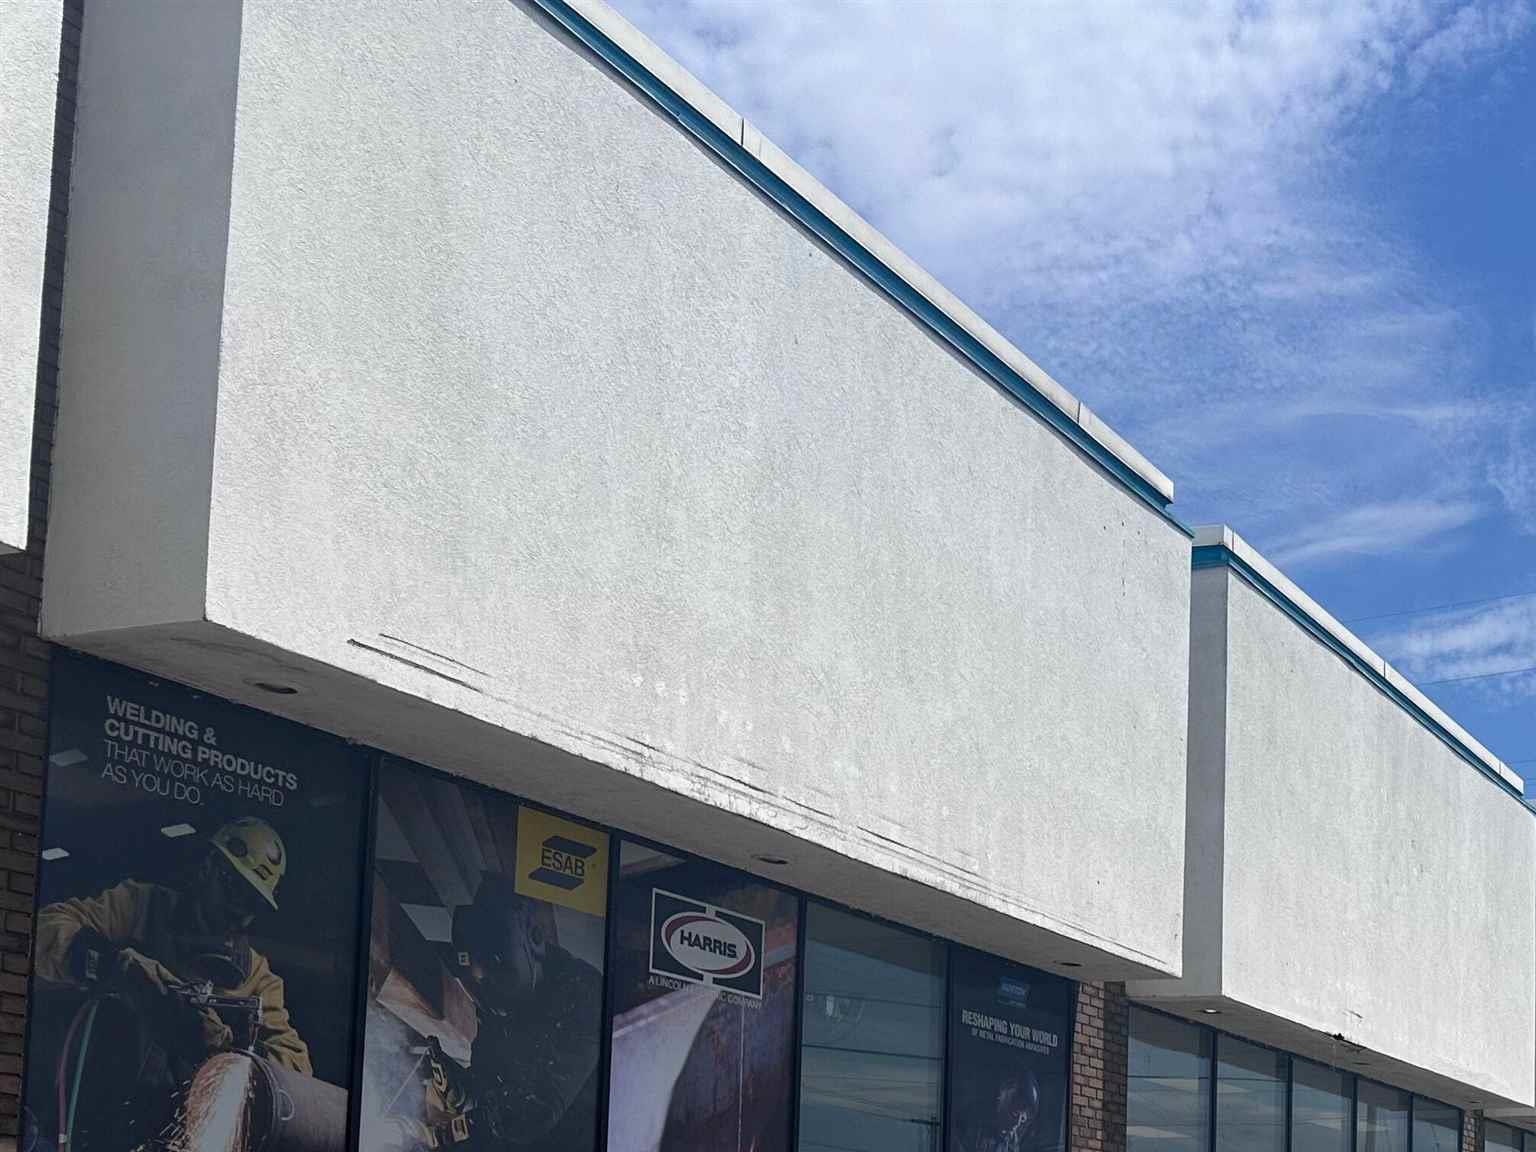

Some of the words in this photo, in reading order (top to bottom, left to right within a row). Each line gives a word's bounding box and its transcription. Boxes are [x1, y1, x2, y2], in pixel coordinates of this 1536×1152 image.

[106, 696, 199, 740] WELDING
[203, 727, 217, 746] &
[103, 739, 150, 767] THAT
[152, 755, 209, 786] WORK
[211, 773, 234, 793] AS
[238, 781, 285, 807] HARD
[104, 718, 193, 759] CUTTING
[198, 746, 298, 790] PRODUCTS
[101, 763, 127, 784] AS
[131, 770, 170, 796] YOU
[541, 848, 585, 877] ESAB
[679, 930, 738, 959] HARRIS
[962, 1009, 1007, 1034] RESHAPING
[1009, 1021, 1030, 1041] YOUR
[1032, 1028, 1058, 1048] WORLD
